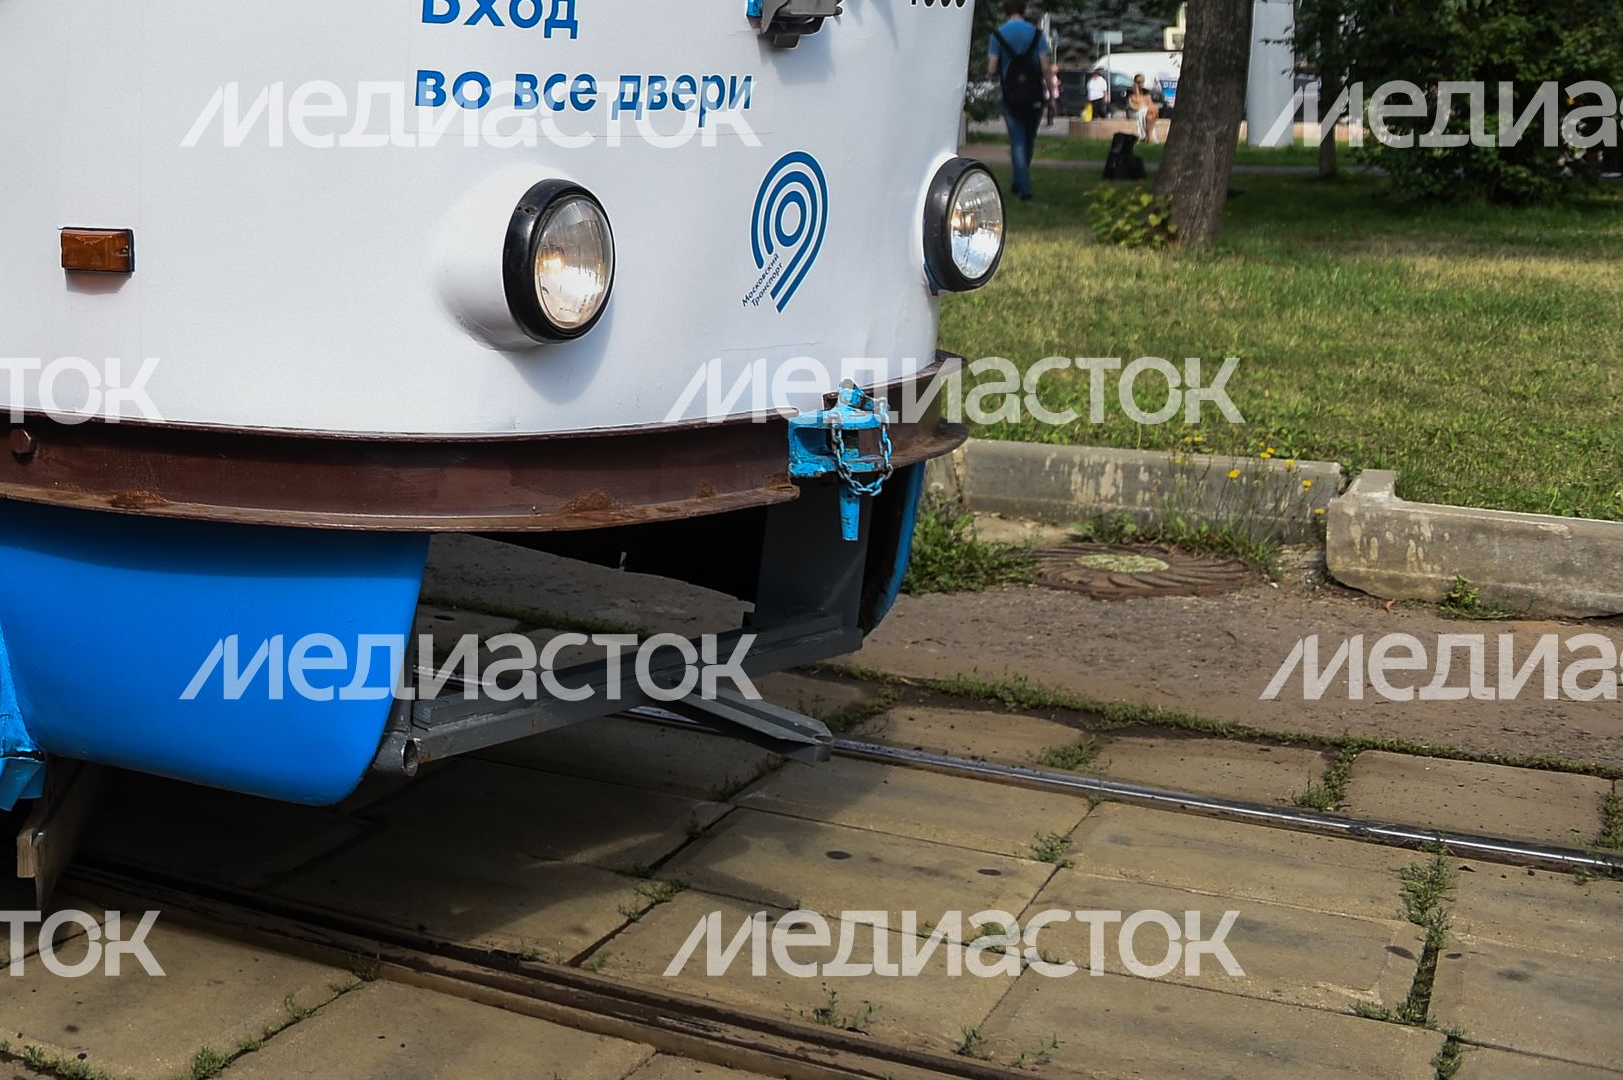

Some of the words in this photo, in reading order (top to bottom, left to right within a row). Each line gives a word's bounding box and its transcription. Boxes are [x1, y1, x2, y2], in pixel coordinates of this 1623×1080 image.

[415, 70, 491, 110] во
[514, 73, 597, 111] все
[612, 75, 752, 128] двери
